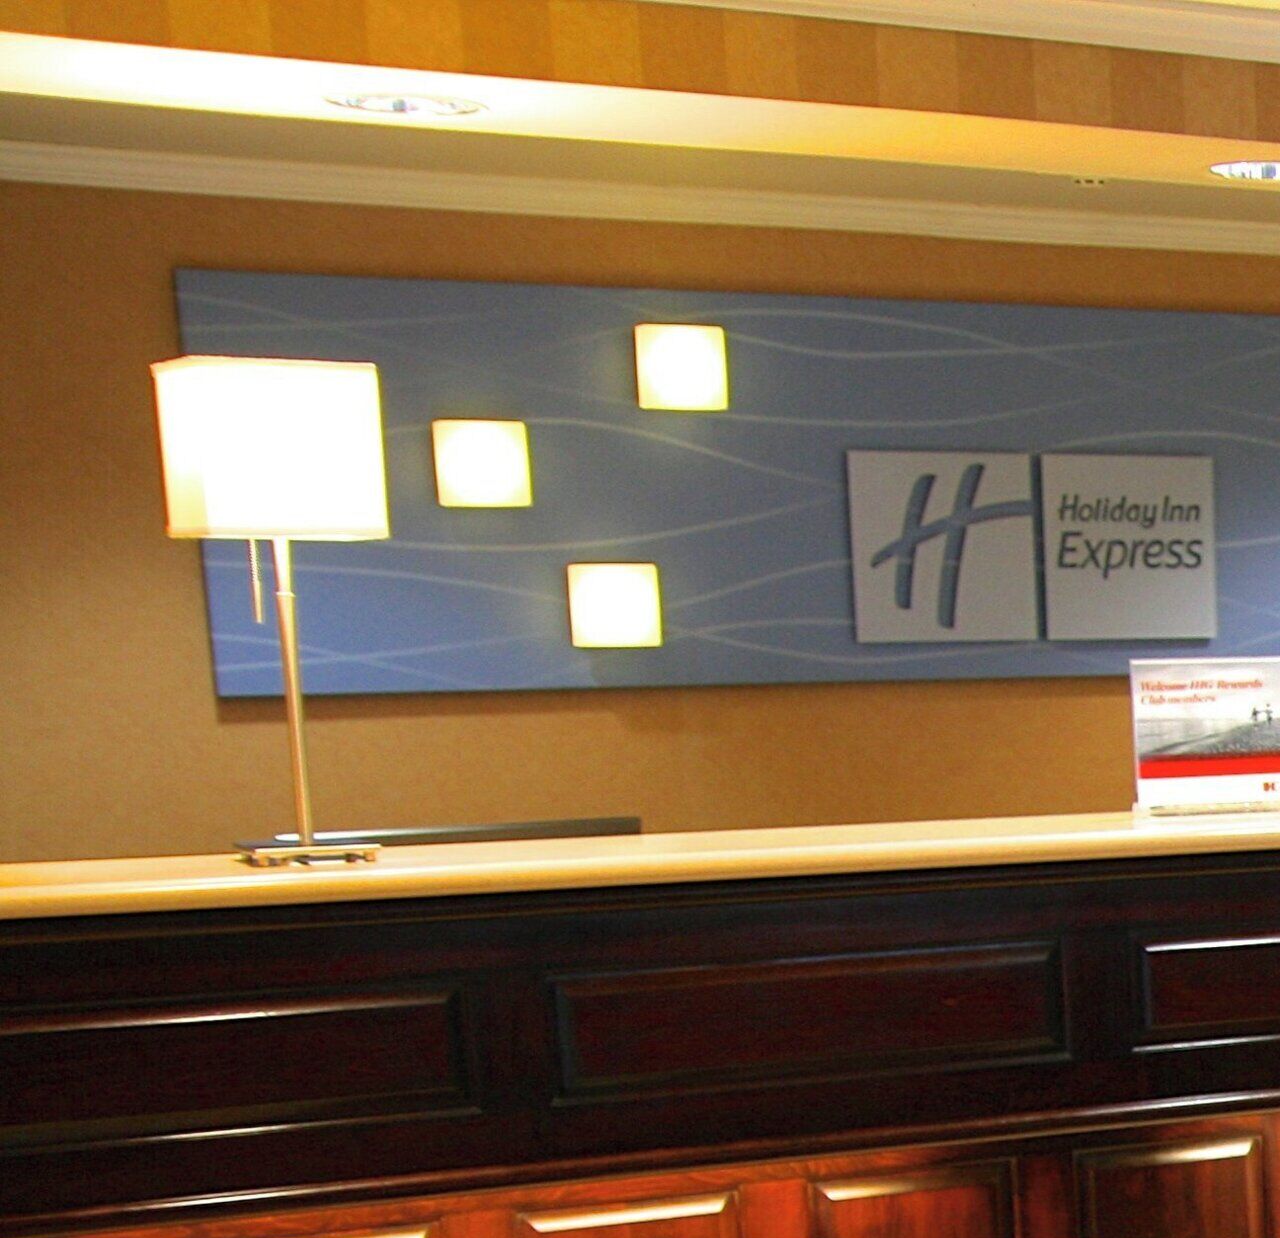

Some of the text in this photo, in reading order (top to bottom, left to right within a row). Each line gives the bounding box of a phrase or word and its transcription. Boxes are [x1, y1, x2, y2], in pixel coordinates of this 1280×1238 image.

[1058, 494, 1200, 529] Holiday Inn
[1057, 531, 1203, 579] Express
[1141, 680, 1187, 692] Welcome
[1167, 694, 1216, 704] members
